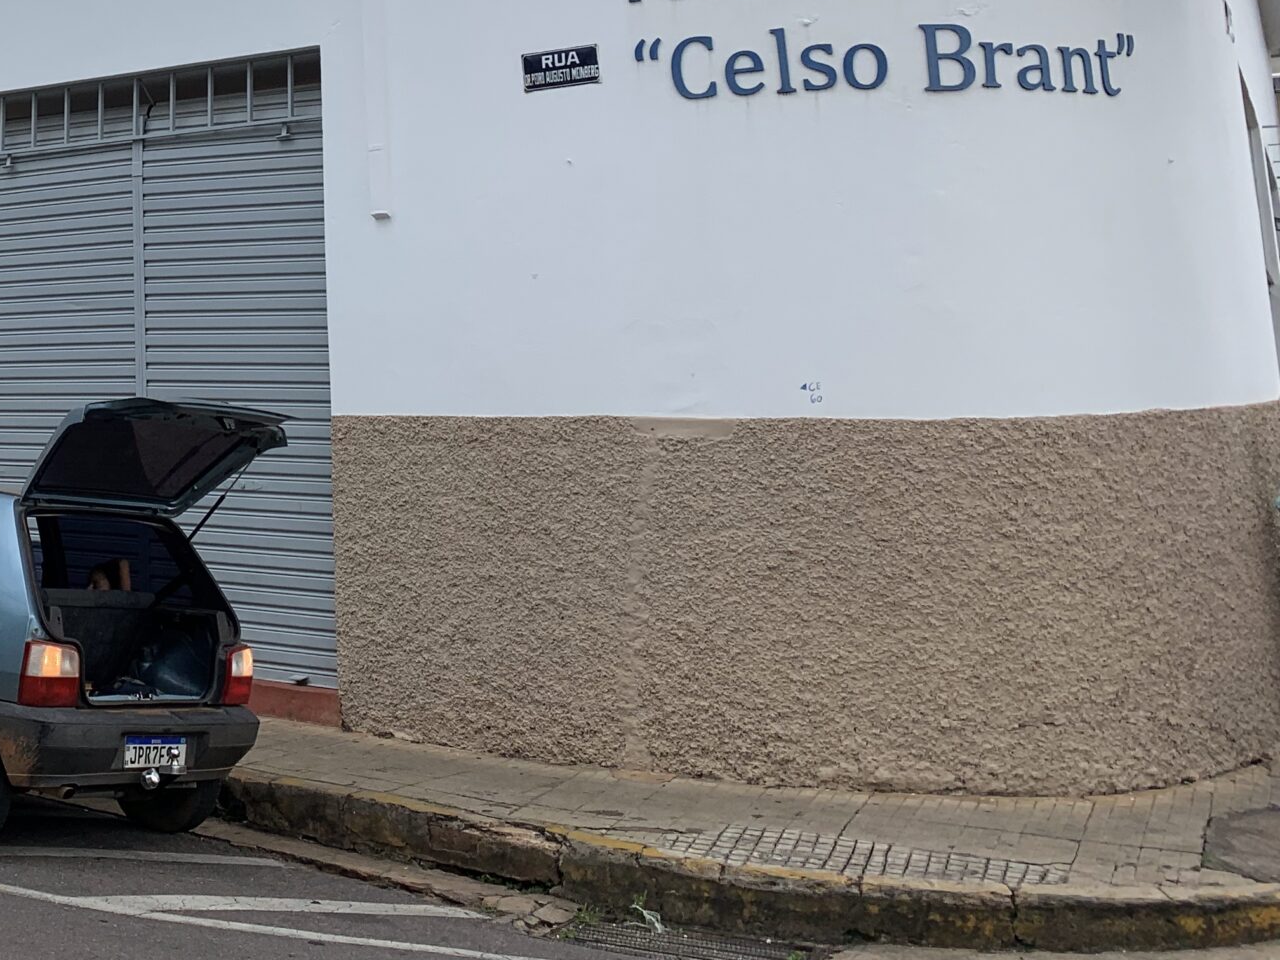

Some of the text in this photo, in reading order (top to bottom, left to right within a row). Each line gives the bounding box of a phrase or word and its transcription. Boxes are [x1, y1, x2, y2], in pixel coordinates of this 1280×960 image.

[541, 51, 580, 69] RUA
[634, 23, 1134, 100] “Celso Brant”
